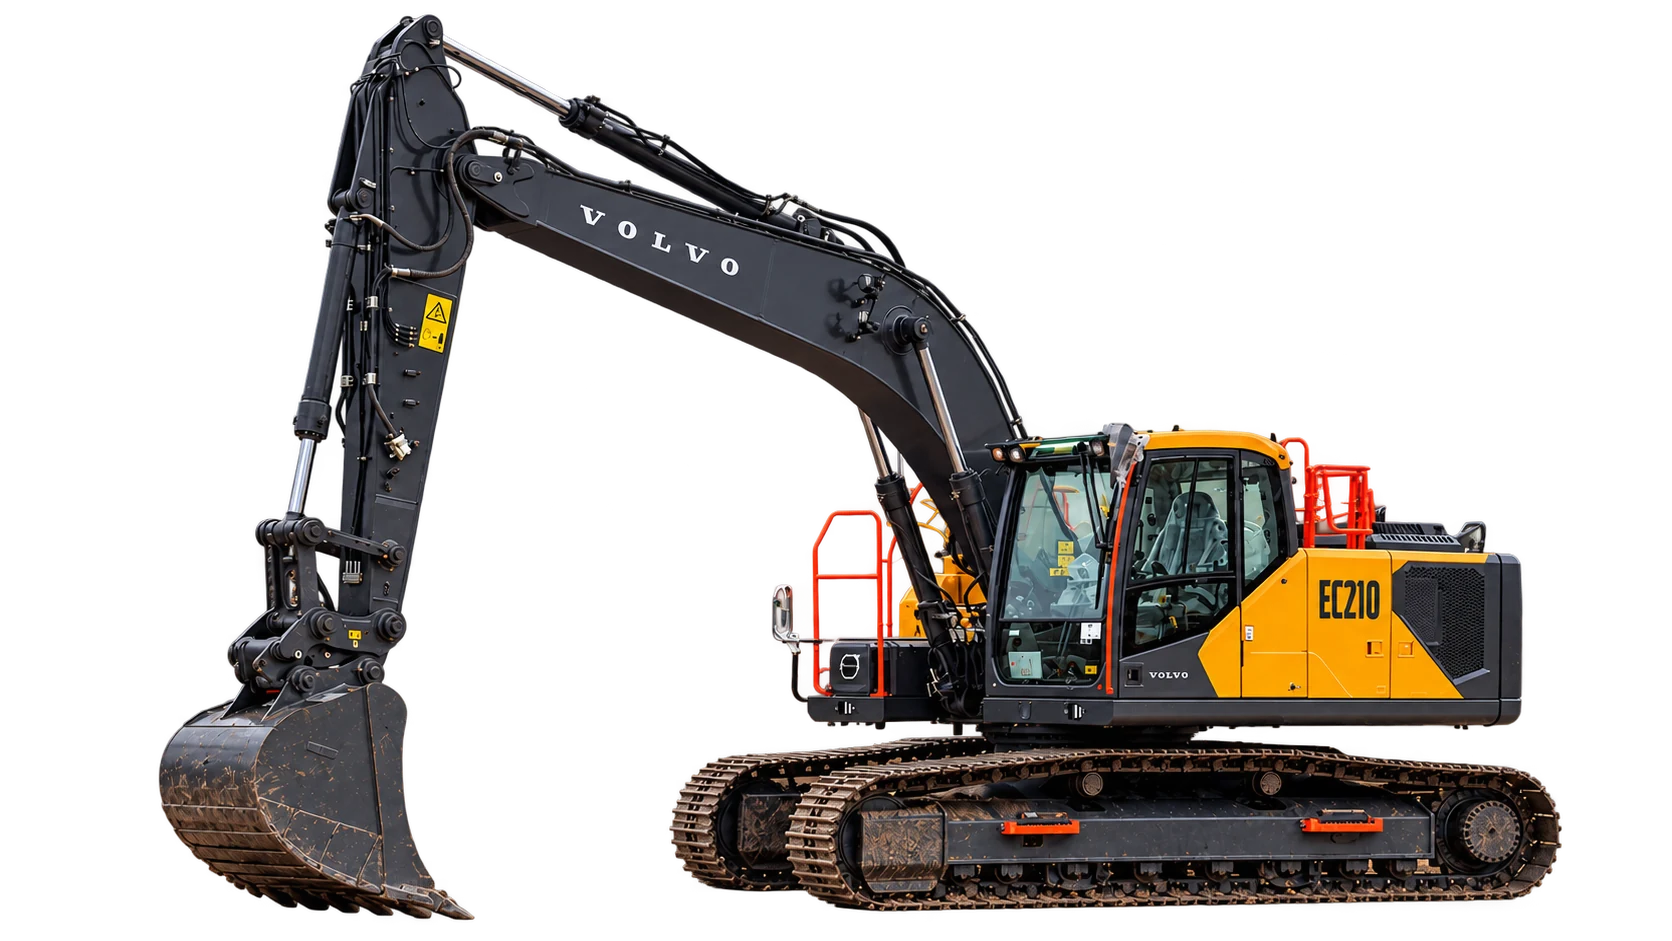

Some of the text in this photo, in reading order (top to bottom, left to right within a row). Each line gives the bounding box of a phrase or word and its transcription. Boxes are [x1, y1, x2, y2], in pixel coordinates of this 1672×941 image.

[580, 204, 740, 276] VOLVO
[1319, 580, 1380, 620] EC210
[1149, 671, 1188, 679] VOLVO
